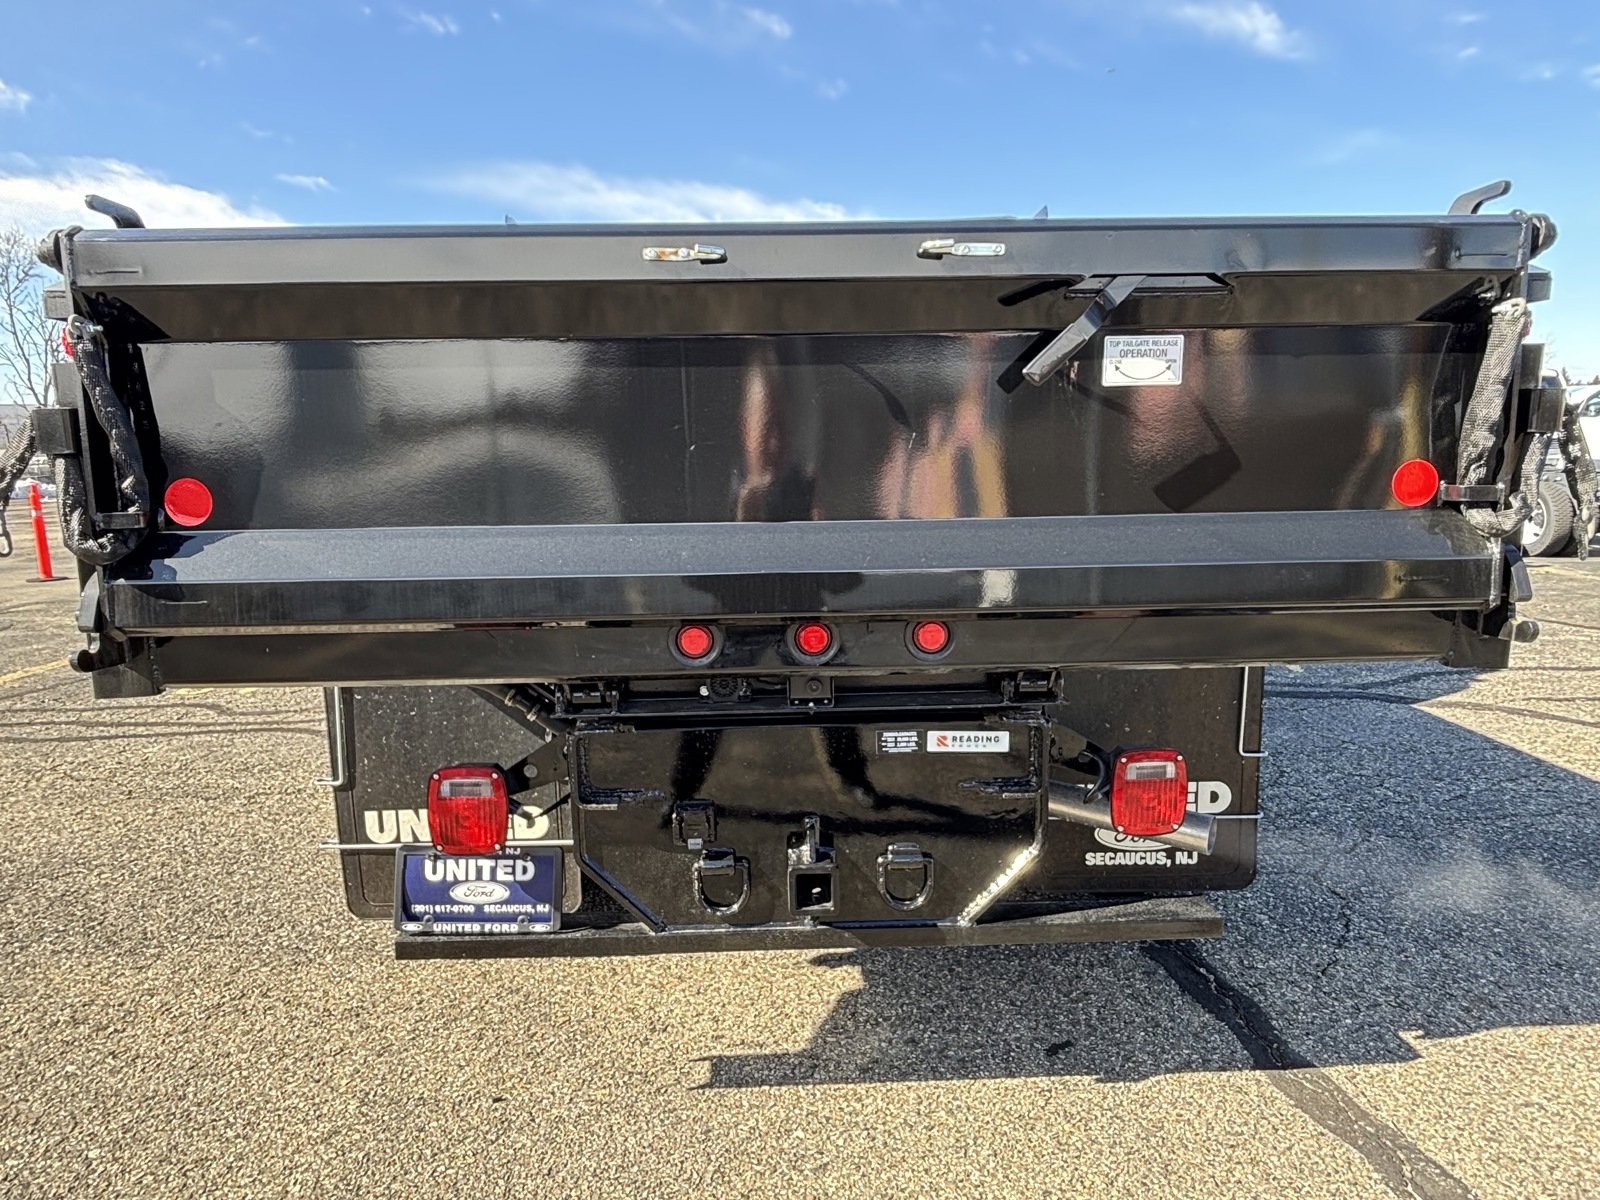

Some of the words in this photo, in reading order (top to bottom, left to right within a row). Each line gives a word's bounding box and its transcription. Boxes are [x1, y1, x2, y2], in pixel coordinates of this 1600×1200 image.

[1123, 340, 1150, 348] TAILGATE
[1151, 339, 1179, 347] RELEASE
[1119, 348, 1168, 358] OPERATION
[952, 735, 1000, 743] READING
[364, 805, 549, 844] UND
[505, 847, 521, 855] NJ
[1085, 851, 1172, 867] SECAUCUS,
[1175, 851, 1199, 865] NJ
[424, 859, 535, 881] UNITED
[464, 885, 494, 898] Ford
[411, 904, 433, 913] (201)
[435, 904, 475, 912] 617-0700
[483, 904, 535, 913] SECAUCUS,
[537, 904, 550, 912] NJ
[433, 923, 481, 932] UNITED
[484, 923, 519, 932] FORD
